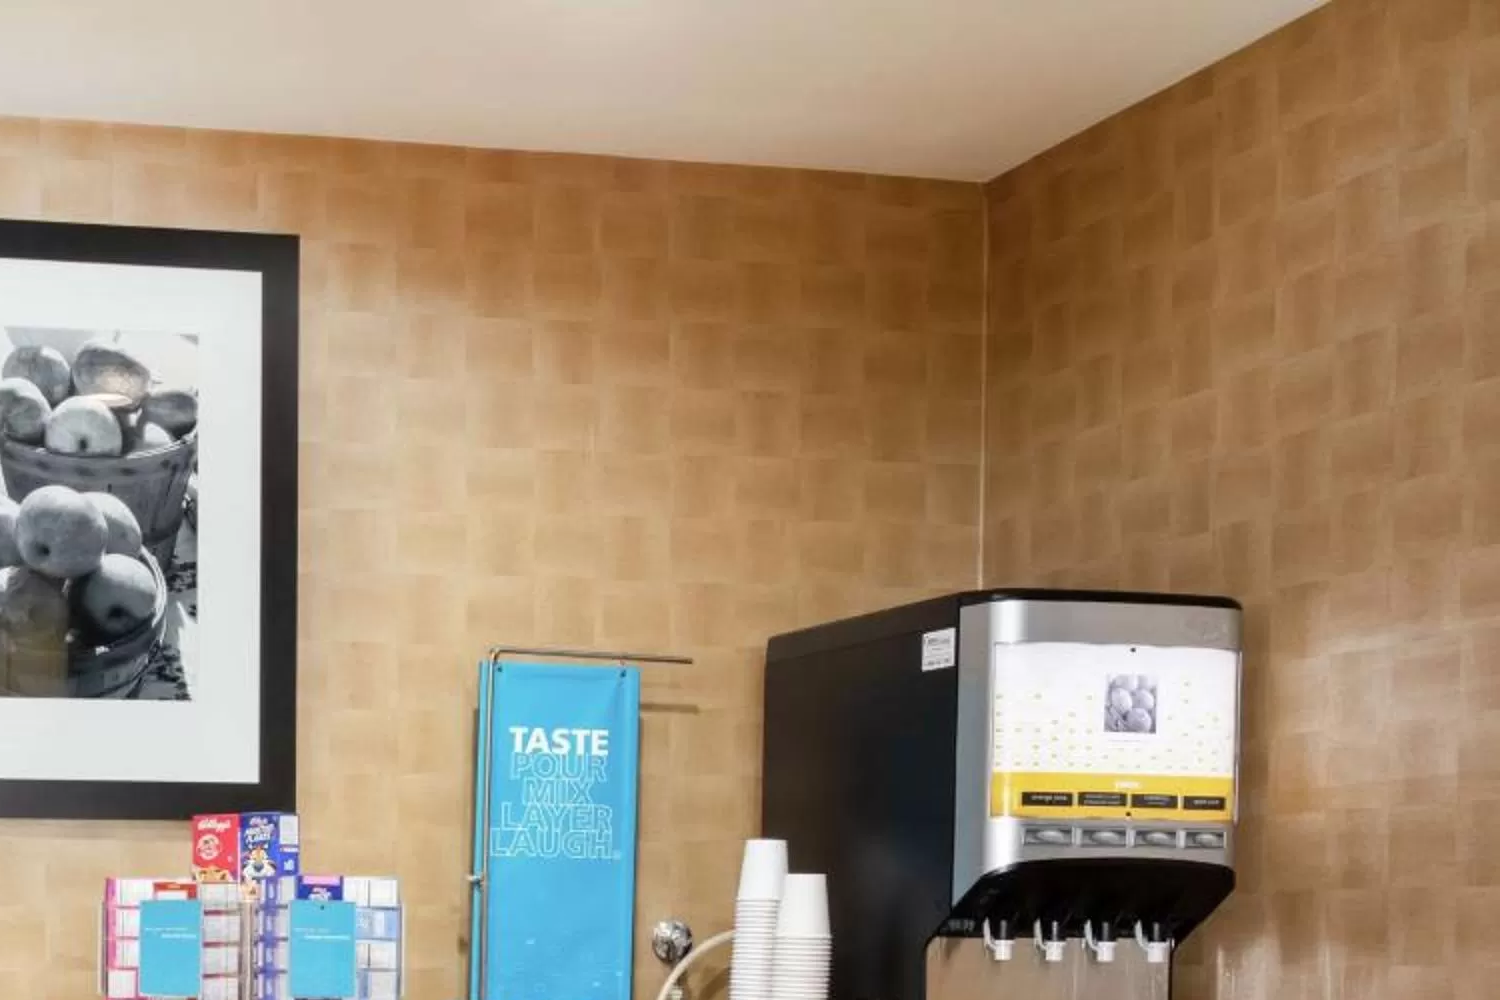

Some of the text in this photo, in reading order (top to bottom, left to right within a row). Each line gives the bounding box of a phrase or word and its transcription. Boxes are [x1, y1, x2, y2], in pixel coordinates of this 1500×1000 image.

[509, 727, 609, 757] TASTE
[511, 752, 608, 782] POUR
[522, 776, 594, 805] MIX
[501, 801, 613, 833] LAYER
[490, 828, 621, 860] LAUGH.
